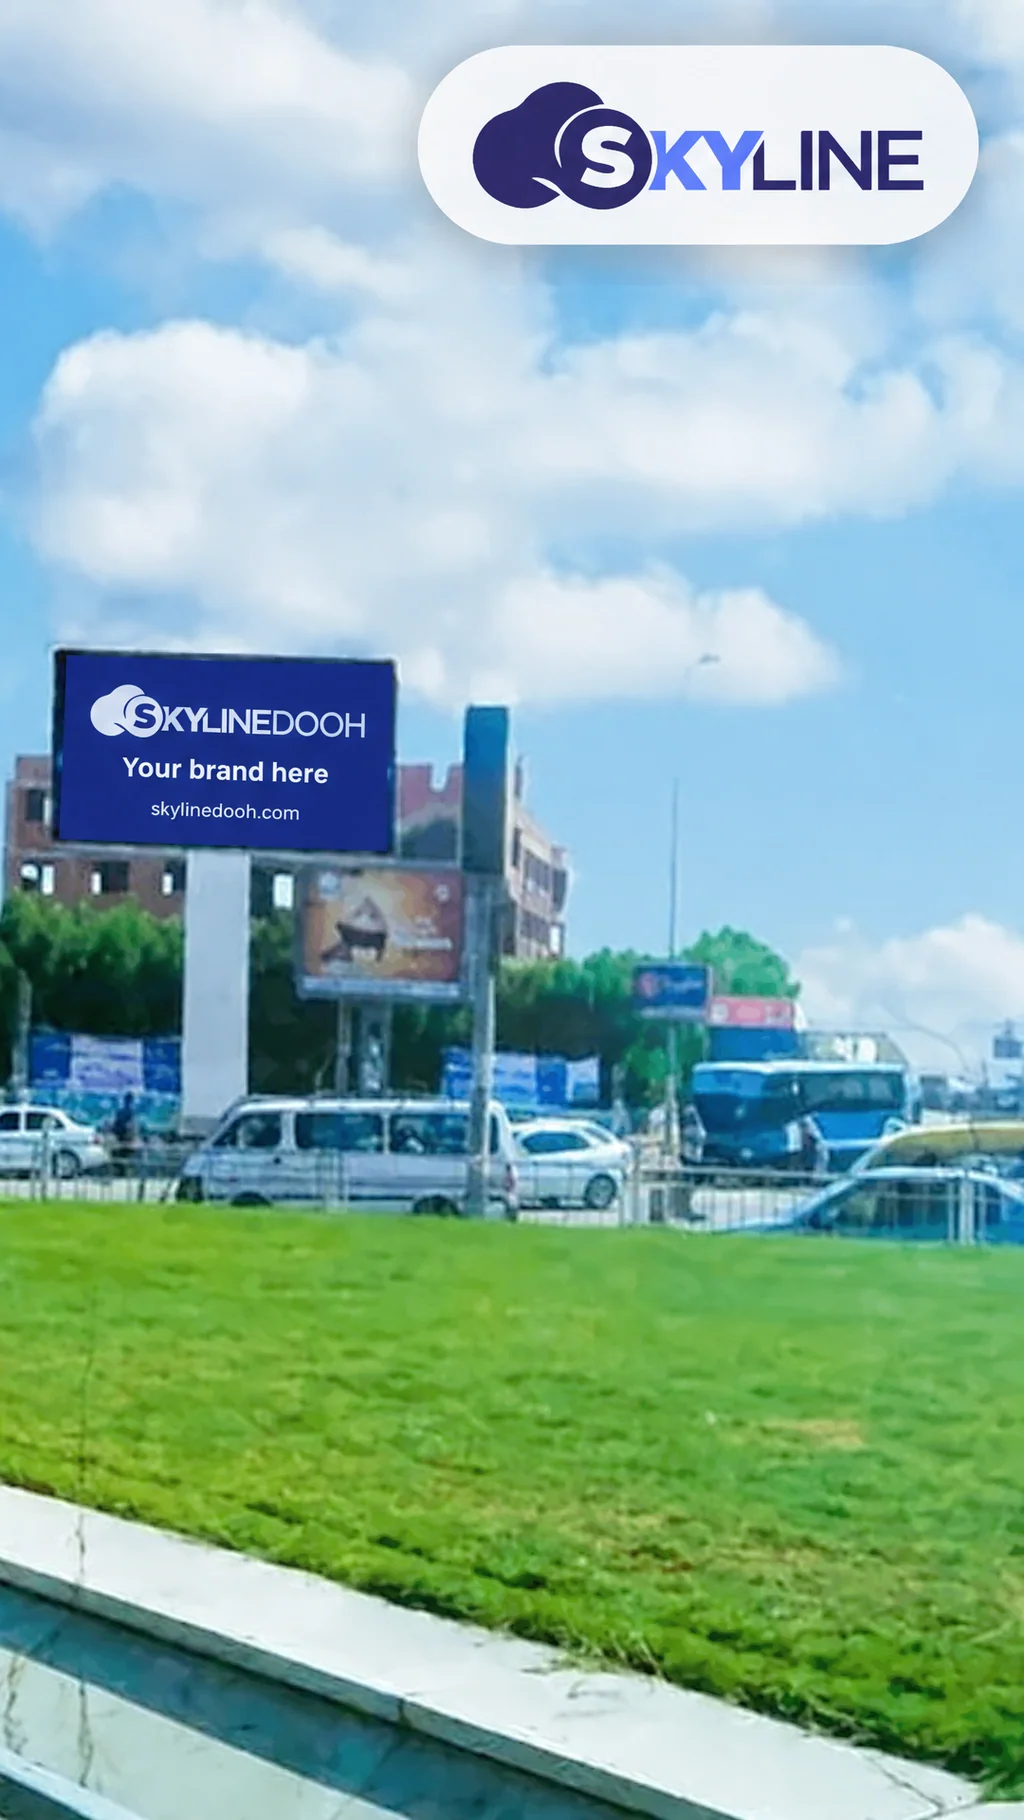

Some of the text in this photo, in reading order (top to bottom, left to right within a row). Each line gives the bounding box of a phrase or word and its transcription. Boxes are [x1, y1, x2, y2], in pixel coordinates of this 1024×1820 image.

[132, 702, 366, 738] SKYLINEDOOH
[122, 756, 329, 784] Your brand here
[150, 800, 300, 821] skylinedooh.com
